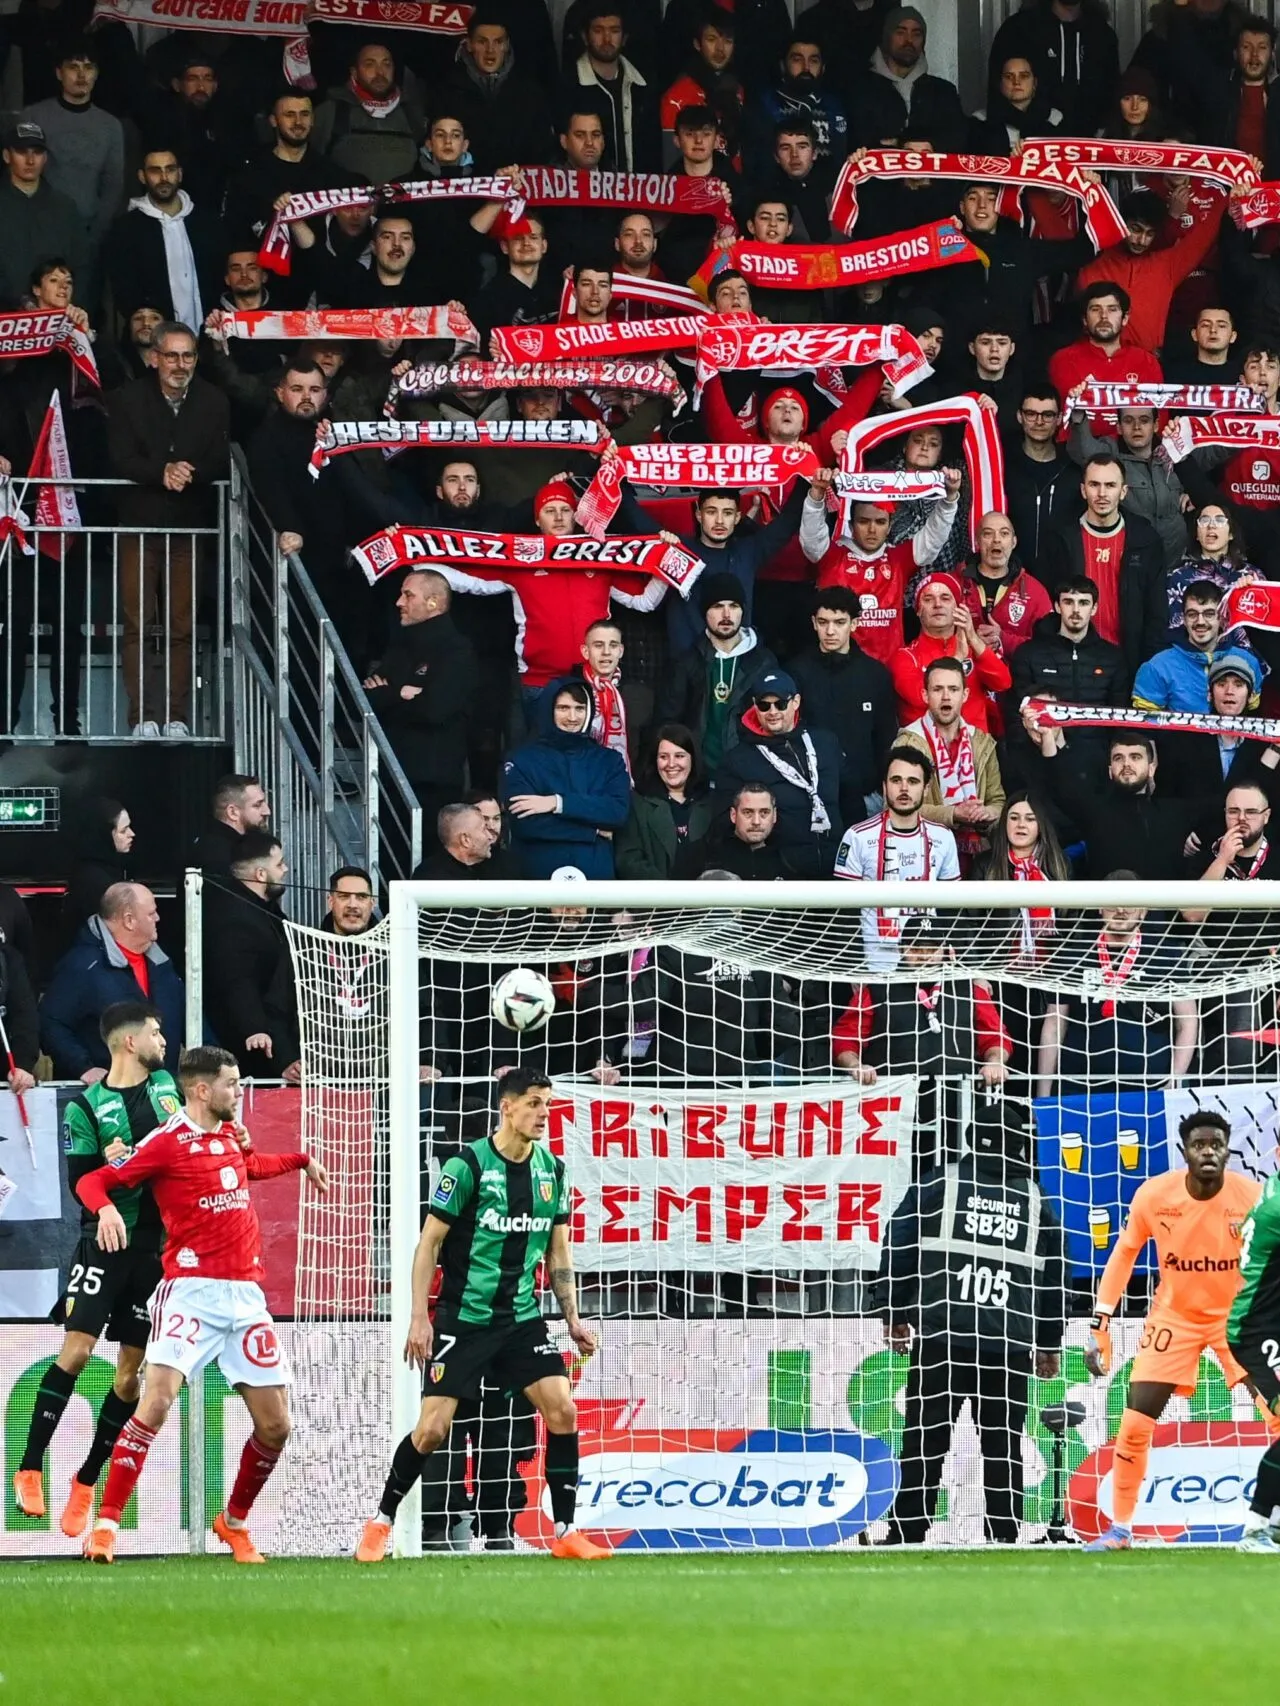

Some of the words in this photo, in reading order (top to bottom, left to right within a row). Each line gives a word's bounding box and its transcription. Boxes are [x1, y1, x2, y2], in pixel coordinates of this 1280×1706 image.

[589, 171, 679, 205] BRESTOIS
[1019, 156, 1100, 208] FANS
[740, 253, 800, 275] STADE
[840, 234, 930, 274] BRESTOIS
[554, 323, 616, 351] STADE
[618, 315, 709, 342] BRESTOIS
[747, 326, 874, 359] BREST
[399, 362, 484, 392] Celtic
[486, 419, 598, 444] VIKEN
[1190, 415, 1260, 440] Allez
[404, 532, 508, 560] ALLEZ
[552, 537, 661, 566] BREST
[479, 1207, 551, 1233] Auchan
[966, 1193, 1021, 1217] SÉCURITÉ
[963, 1210, 1019, 1241] SB29
[66, 1263, 105, 1297] 25
[956, 1263, 1011, 1307] 105
[166, 1312, 201, 1346] 22
[1140, 1326, 1173, 1354] 30
[433, 1333, 457, 1362] 7
[575, 1464, 845, 1509] trecobat
